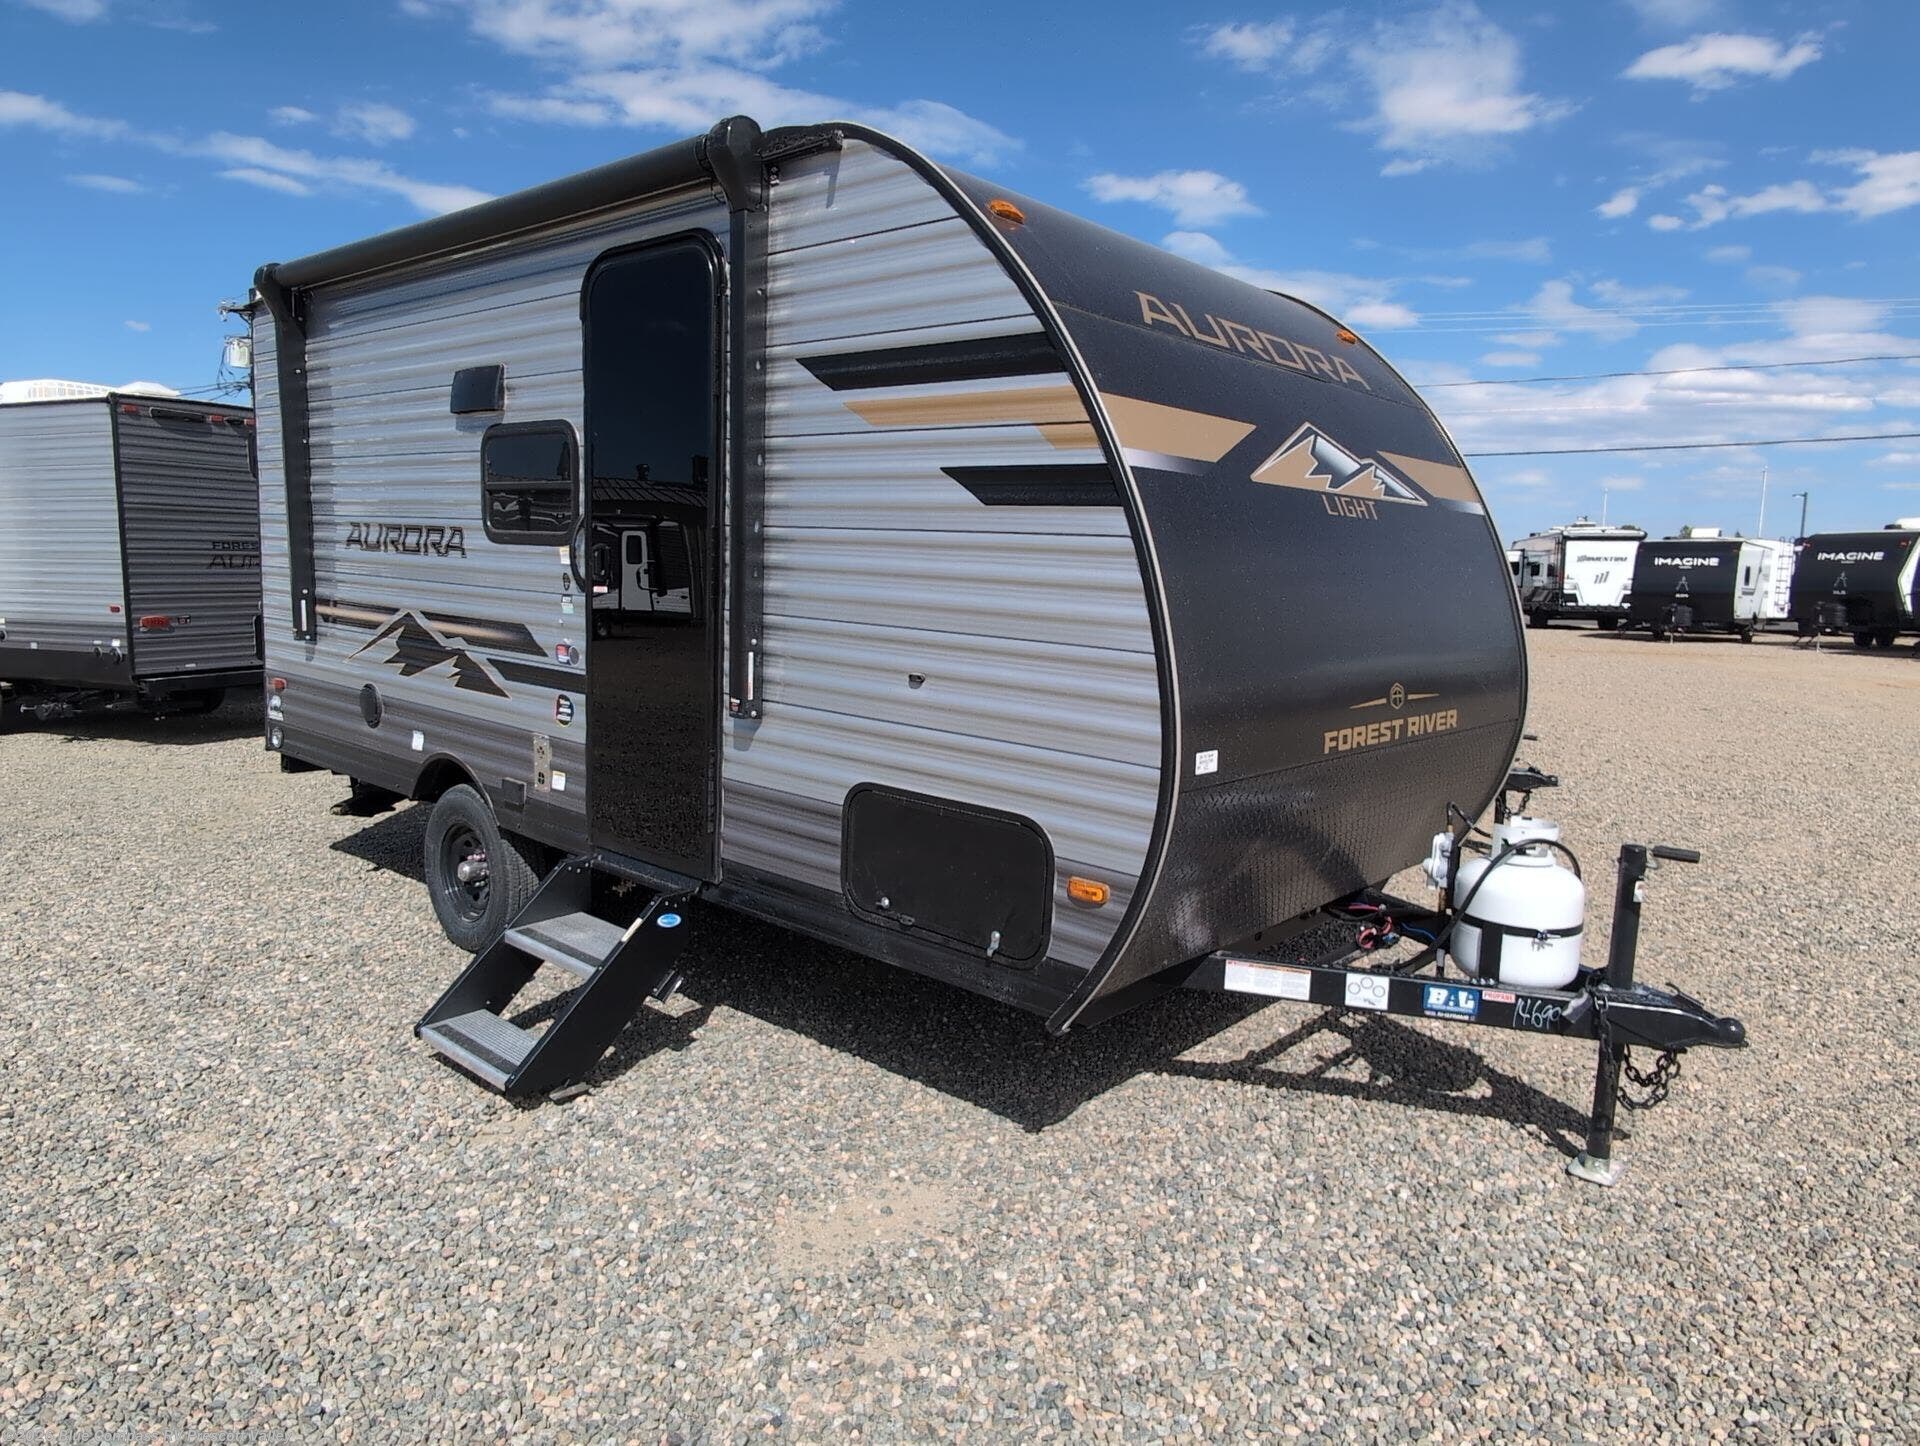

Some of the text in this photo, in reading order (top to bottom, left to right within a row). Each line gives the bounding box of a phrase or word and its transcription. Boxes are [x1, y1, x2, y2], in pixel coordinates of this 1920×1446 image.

[1133, 290, 1372, 391] AURORA
[1322, 494, 1379, 521] LIGHT
[345, 522, 467, 559] AURORA
[1817, 551, 1884, 560] IMAGINE
[1654, 557, 1720, 566] IMAGINE
[1324, 708, 1458, 754] FOREST RIVER
